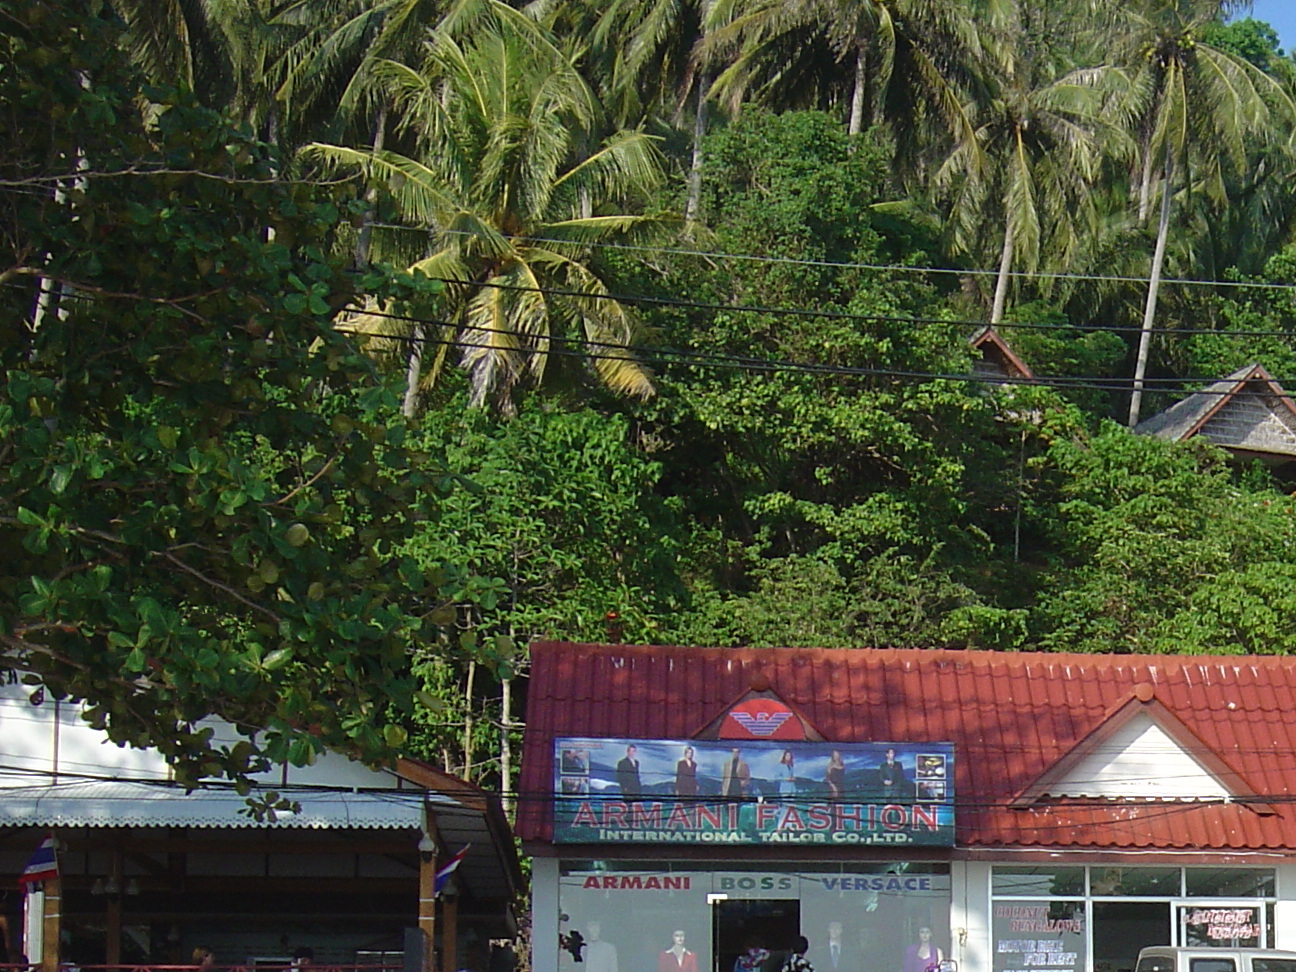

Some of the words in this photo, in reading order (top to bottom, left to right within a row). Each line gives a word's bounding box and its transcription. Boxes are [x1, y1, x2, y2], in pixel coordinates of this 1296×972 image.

[570, 801, 738, 830] ARMANI
[755, 802, 939, 831] FASHION
[599, 829, 752, 842] INTERNATIONAL
[583, 876, 692, 890] ARMANI
[720, 877, 792, 890] BOSS
[821, 877, 931, 890] VERSACE
[1023, 952, 1047, 966] FOR
[1047, 952, 1077, 966] RENT
